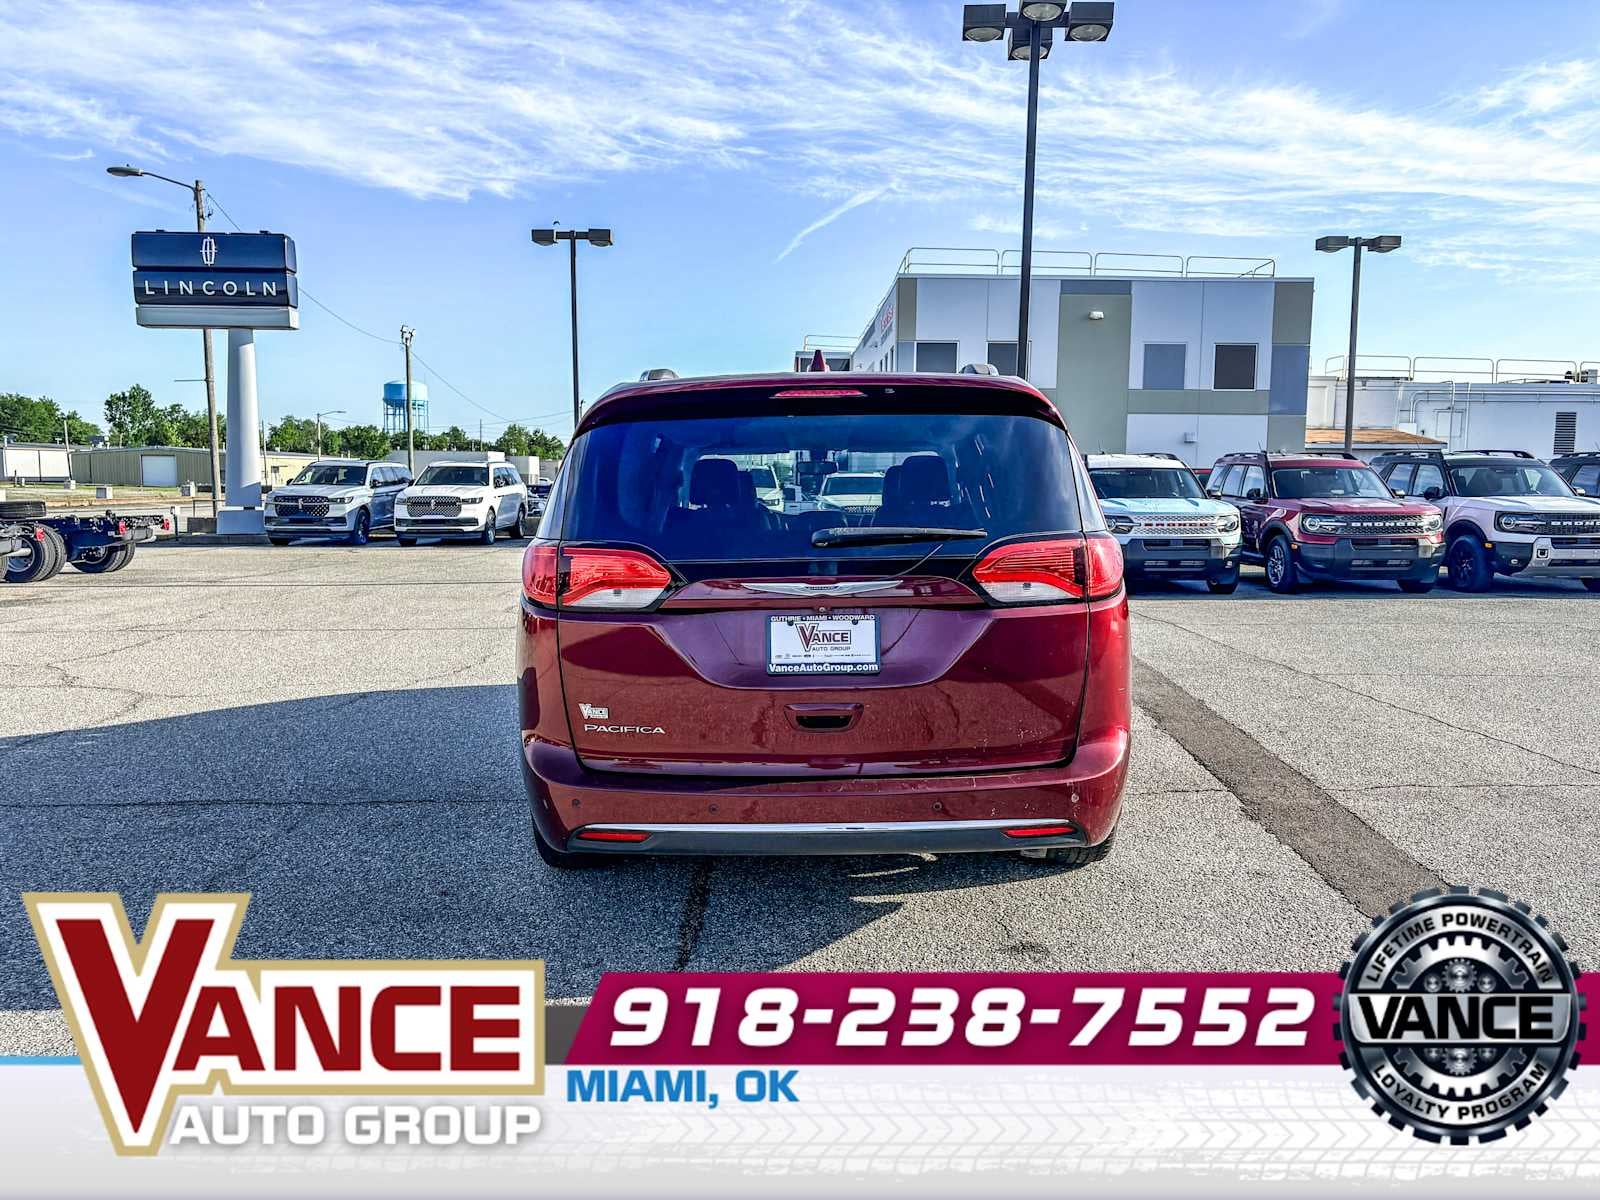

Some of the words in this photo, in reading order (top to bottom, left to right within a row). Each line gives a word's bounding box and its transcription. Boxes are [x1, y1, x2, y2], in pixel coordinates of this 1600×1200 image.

[144, 280, 277, 296] LINCOLN
[798, 624, 849, 650] VANCE
[768, 663, 878, 672] VanceAutoGroup.com
[584, 724, 666, 734] PACIFICA
